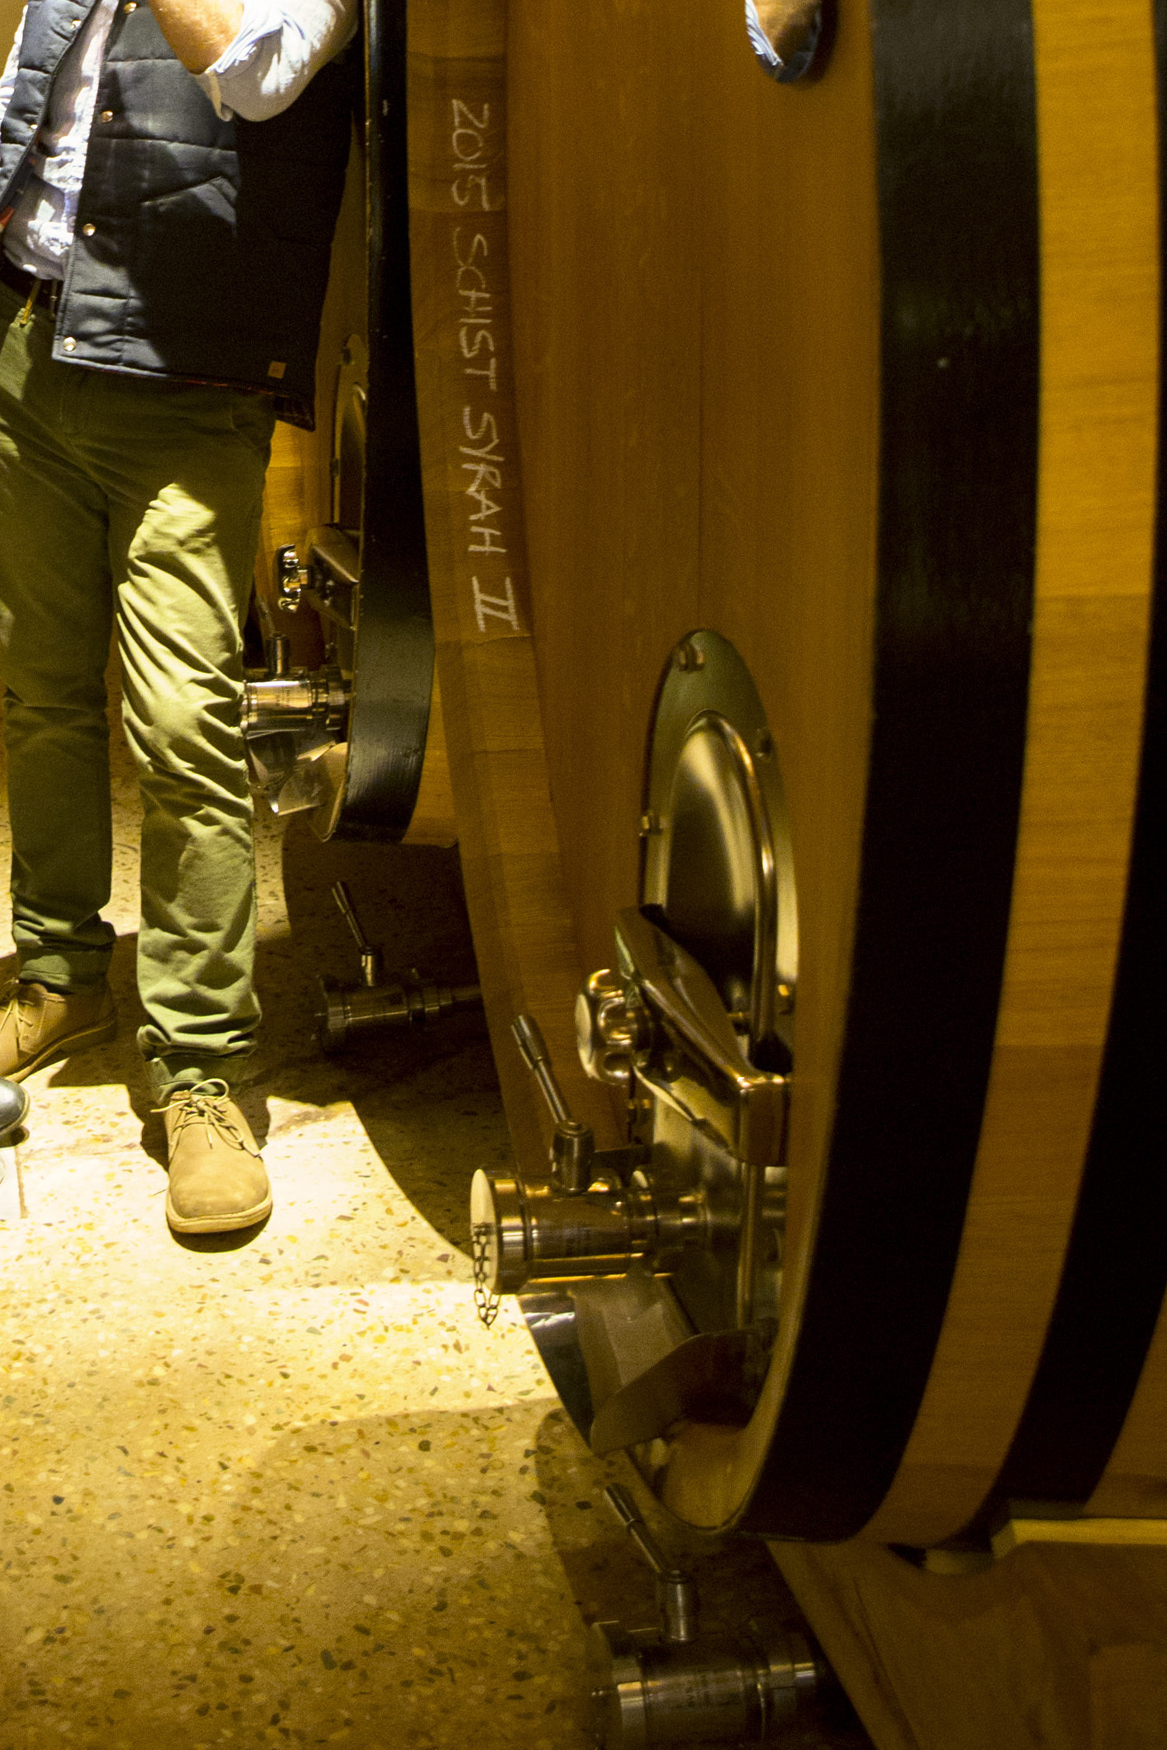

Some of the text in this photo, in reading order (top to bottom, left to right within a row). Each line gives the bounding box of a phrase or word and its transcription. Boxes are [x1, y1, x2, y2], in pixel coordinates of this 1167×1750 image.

[452, 98, 520, 632] 2015 SCHIST SYRAH II
